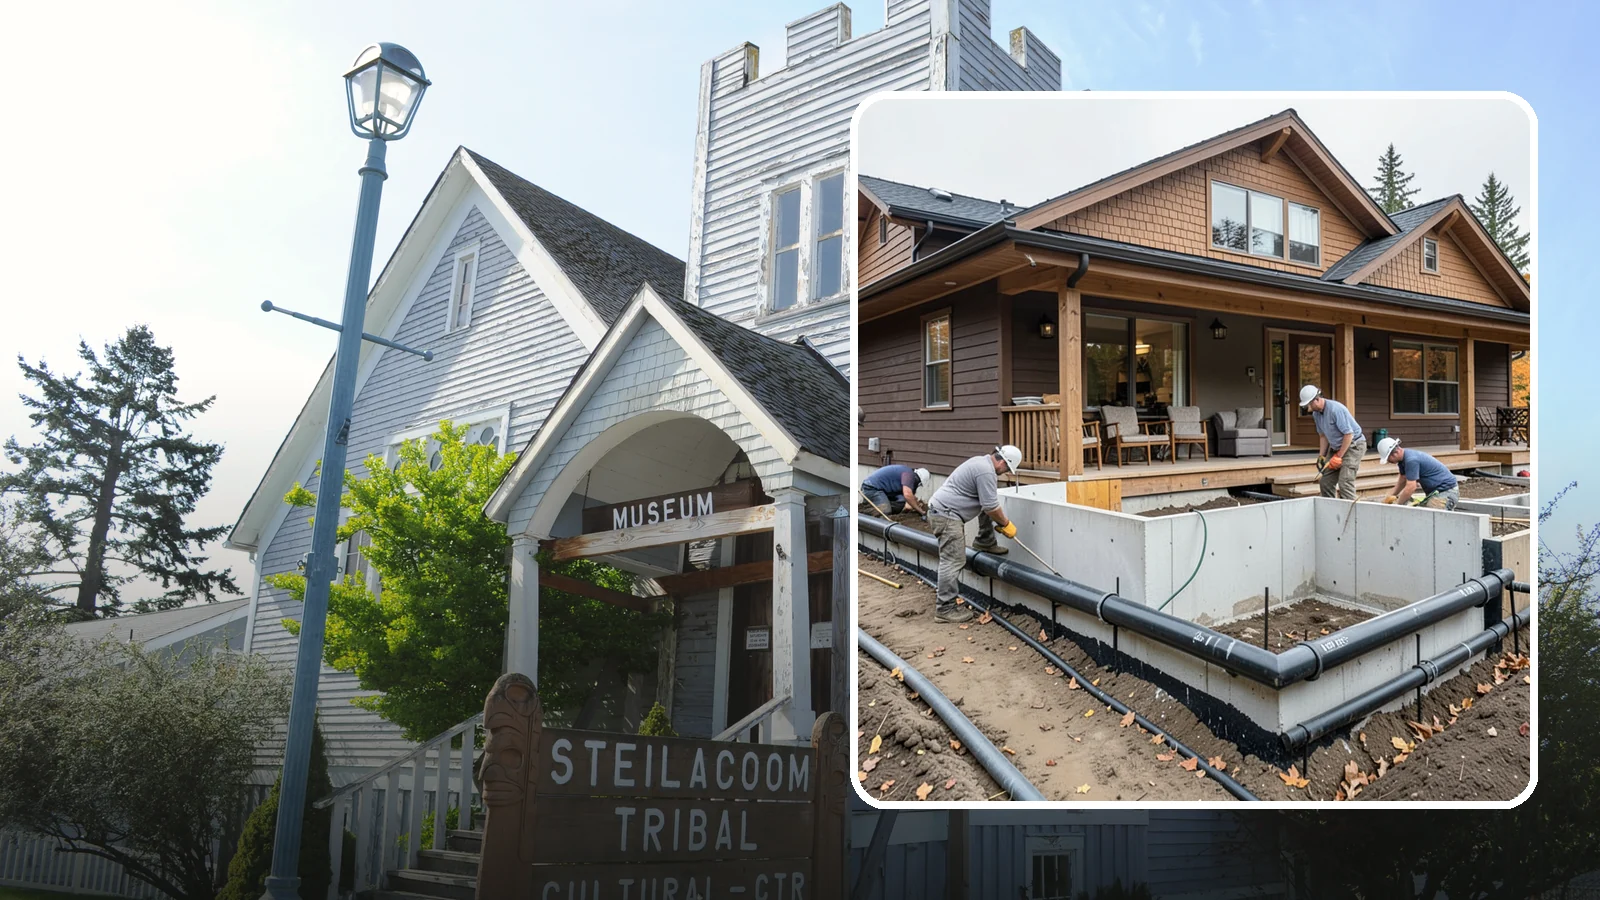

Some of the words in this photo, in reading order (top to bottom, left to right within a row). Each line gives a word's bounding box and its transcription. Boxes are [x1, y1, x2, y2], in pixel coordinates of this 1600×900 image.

[612, 491, 714, 531] MUSEUM
[550, 738, 810, 793] STEILACOOM
[615, 806, 758, 852] TRIBAL
